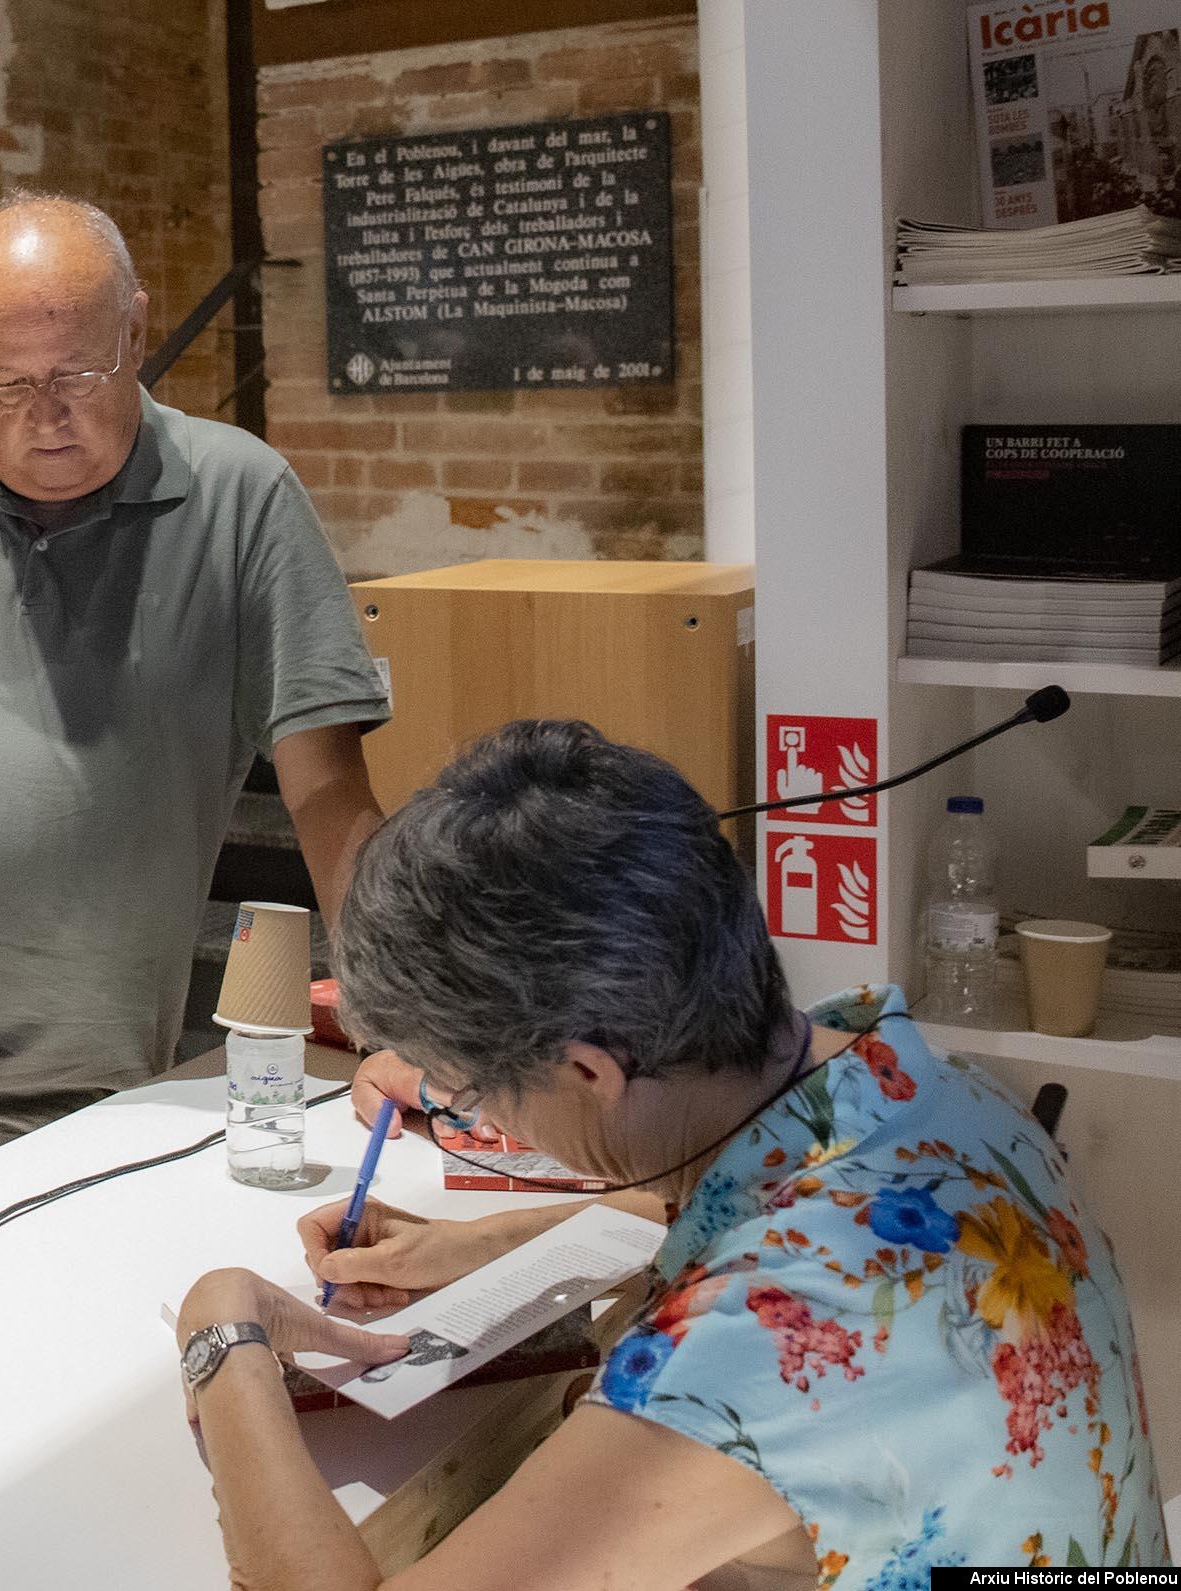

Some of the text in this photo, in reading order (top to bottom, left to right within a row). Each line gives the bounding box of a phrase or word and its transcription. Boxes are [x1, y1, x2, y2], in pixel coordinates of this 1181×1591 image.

[980, 0, 1110, 50] Icària
[346, 126, 636, 167] En el Poblenou, i davant del mar, la
[336, 174, 370, 189] Torre
[379, 170, 394, 184] de
[404, 168, 423, 182] les
[494, 159, 526, 173] obra
[537, 154, 554, 169] de
[565, 147, 647, 167] l'arquitecte
[366, 192, 396, 206] Pere
[470, 184, 485, 197] és
[495, 175, 563, 194] testimoni
[573, 173, 591, 188] de
[601, 171, 615, 185] la
[346, 189, 639, 227] industrialització de Catalunya i de la
[362, 230, 399, 245] lluita
[409, 227, 415, 241] i
[481, 220, 508, 236] dels
[519, 214, 606, 233] treballadors
[616, 211, 622, 226] i
[337, 231, 653, 266] treballadores de CAN GIRONA-MACOSA
[430, 267, 455, 280] que
[464, 260, 542, 277] actualment
[554, 254, 618, 271] continua
[629, 255, 639, 266] a
[357, 289, 396, 304] Santa
[478, 282, 494, 296] de
[505, 280, 518, 295] la
[529, 276, 588, 294] Mogoda
[599, 276, 631, 289] com
[362, 295, 627, 323] ALSTOM (La Maquinista-Macosa)
[379, 372, 449, 386] de Barcelona
[380, 359, 451, 372] Ajuntament
[513, 367, 520, 381] 1
[527, 367, 543, 381] de
[551, 367, 586, 382] maig
[593, 365, 610, 379] de
[985, 446, 1124, 459] COPS DE COOPERACIÓ
[986, 438, 1081, 447] UN BARRI FET A
